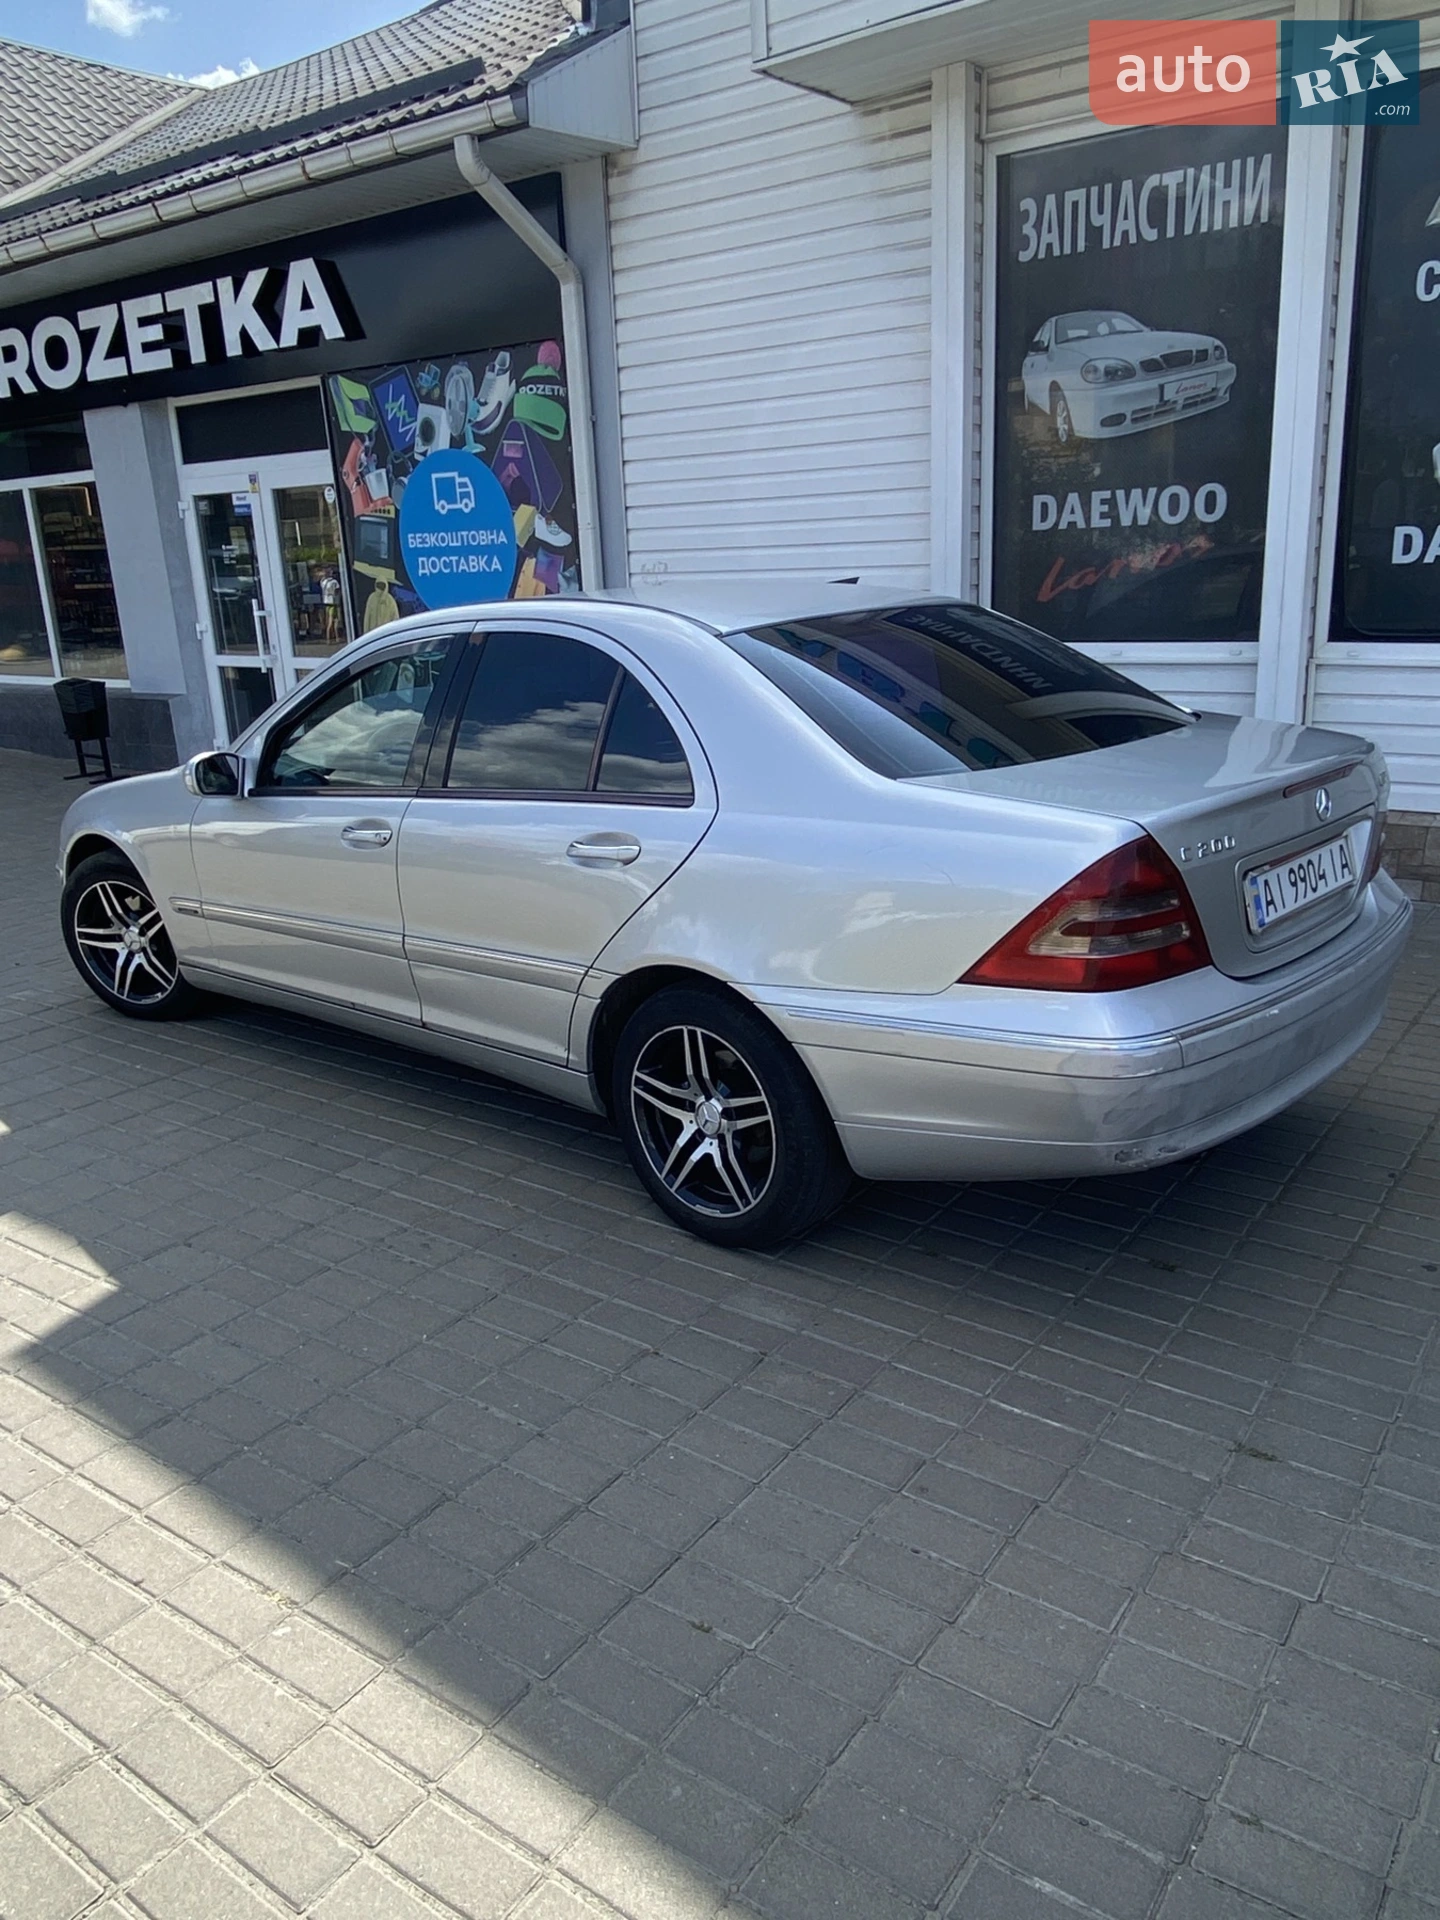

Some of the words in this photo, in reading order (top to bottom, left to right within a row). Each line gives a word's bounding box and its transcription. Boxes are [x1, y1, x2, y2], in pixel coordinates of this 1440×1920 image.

[1018, 153, 1273, 263] ЗАПЧАСТИНИ
[0, 257, 346, 399] ROZETKA
[1032, 482, 1228, 532] DAEWOO
[408, 529, 508, 548] БЕЗКОШТОВНА
[418, 554, 503, 576] ДОСТАВКА
[1197, 835, 1236, 859] 200
[1288, 854, 1328, 904] 9904
